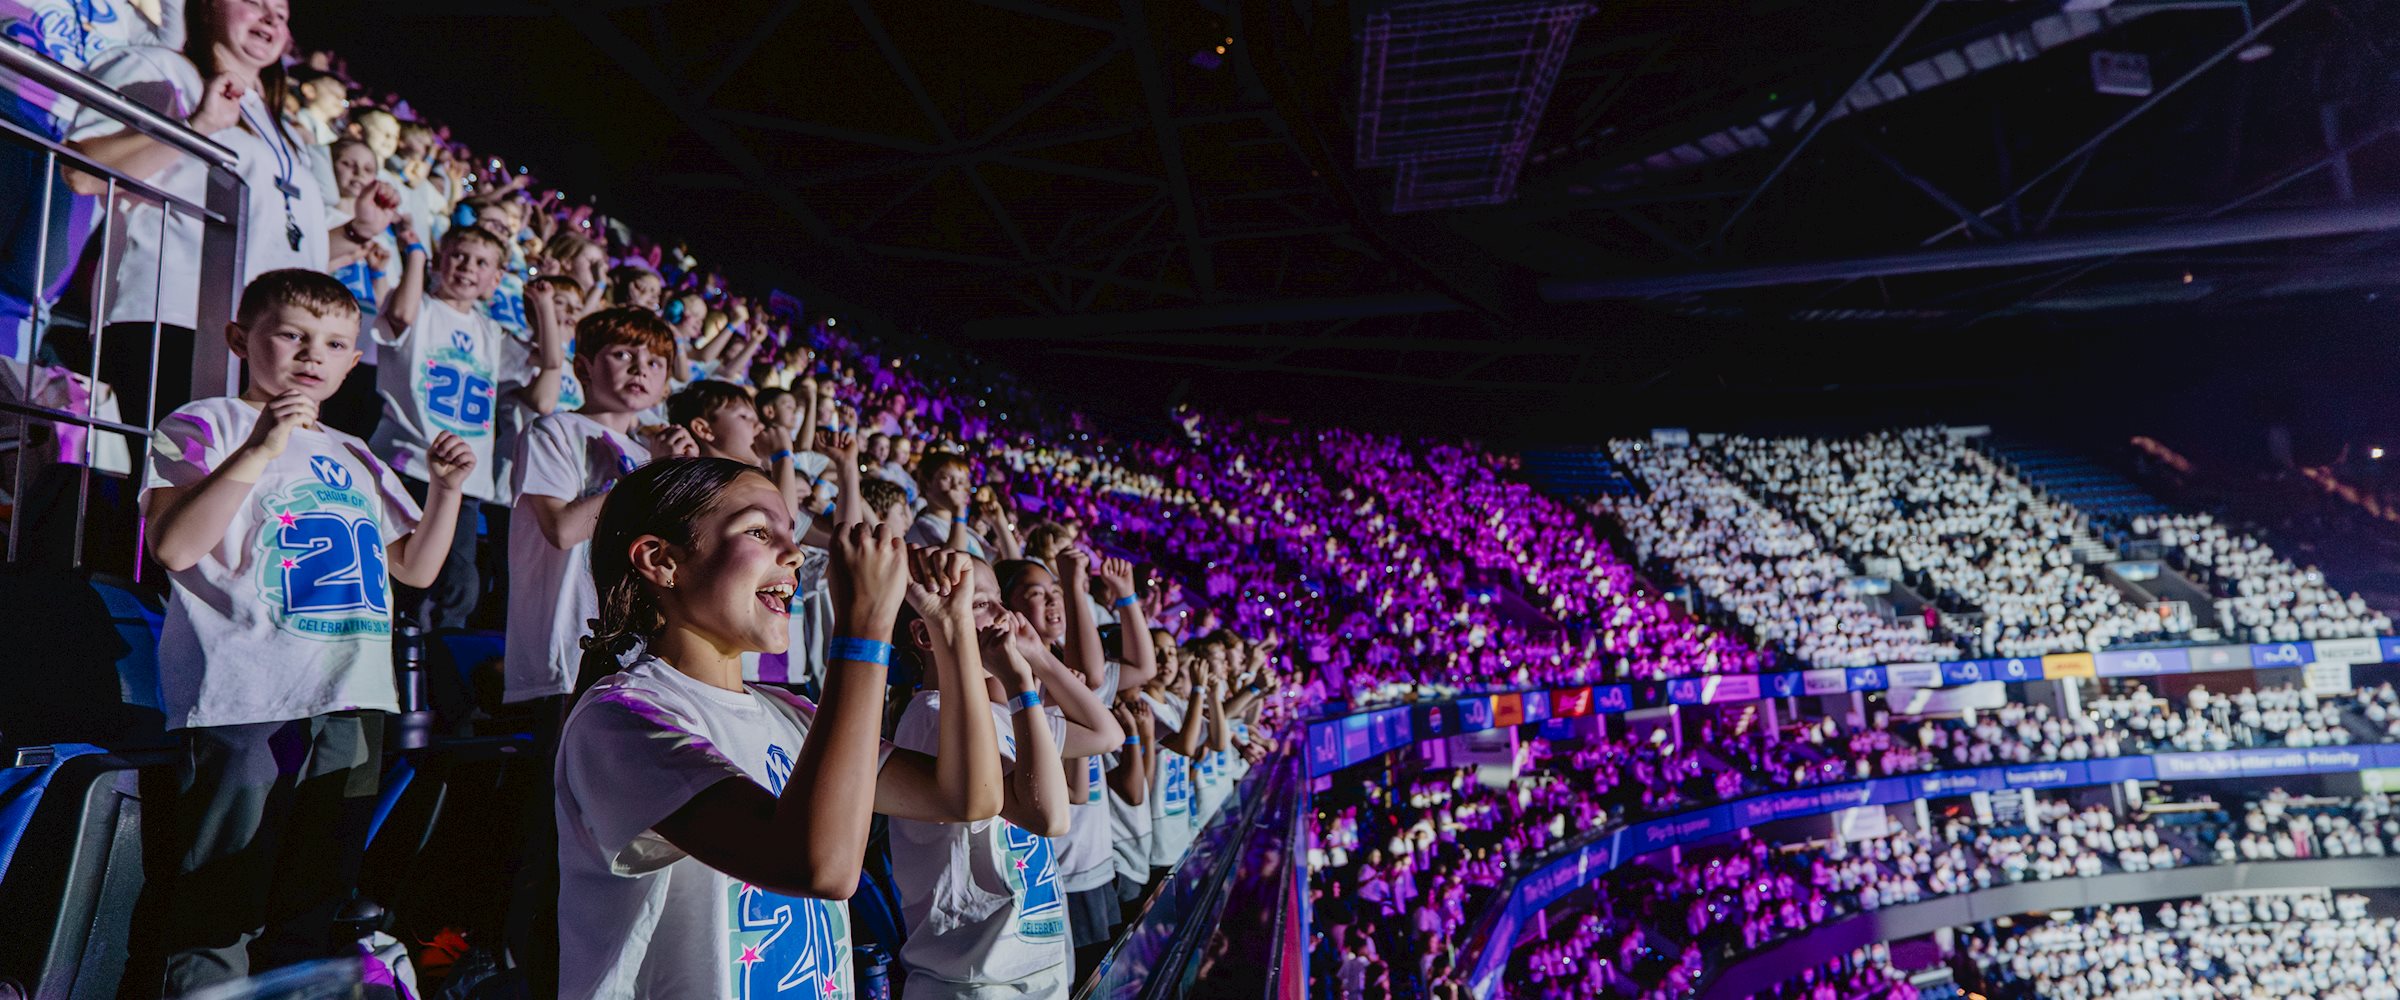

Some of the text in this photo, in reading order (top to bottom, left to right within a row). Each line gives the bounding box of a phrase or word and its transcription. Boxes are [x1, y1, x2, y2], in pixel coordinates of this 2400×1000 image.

[425, 364, 492, 426] 26
[316, 489, 349, 503] CHOIR
[276, 511, 388, 616] 26
[298, 618, 372, 634] CELEBRATING
